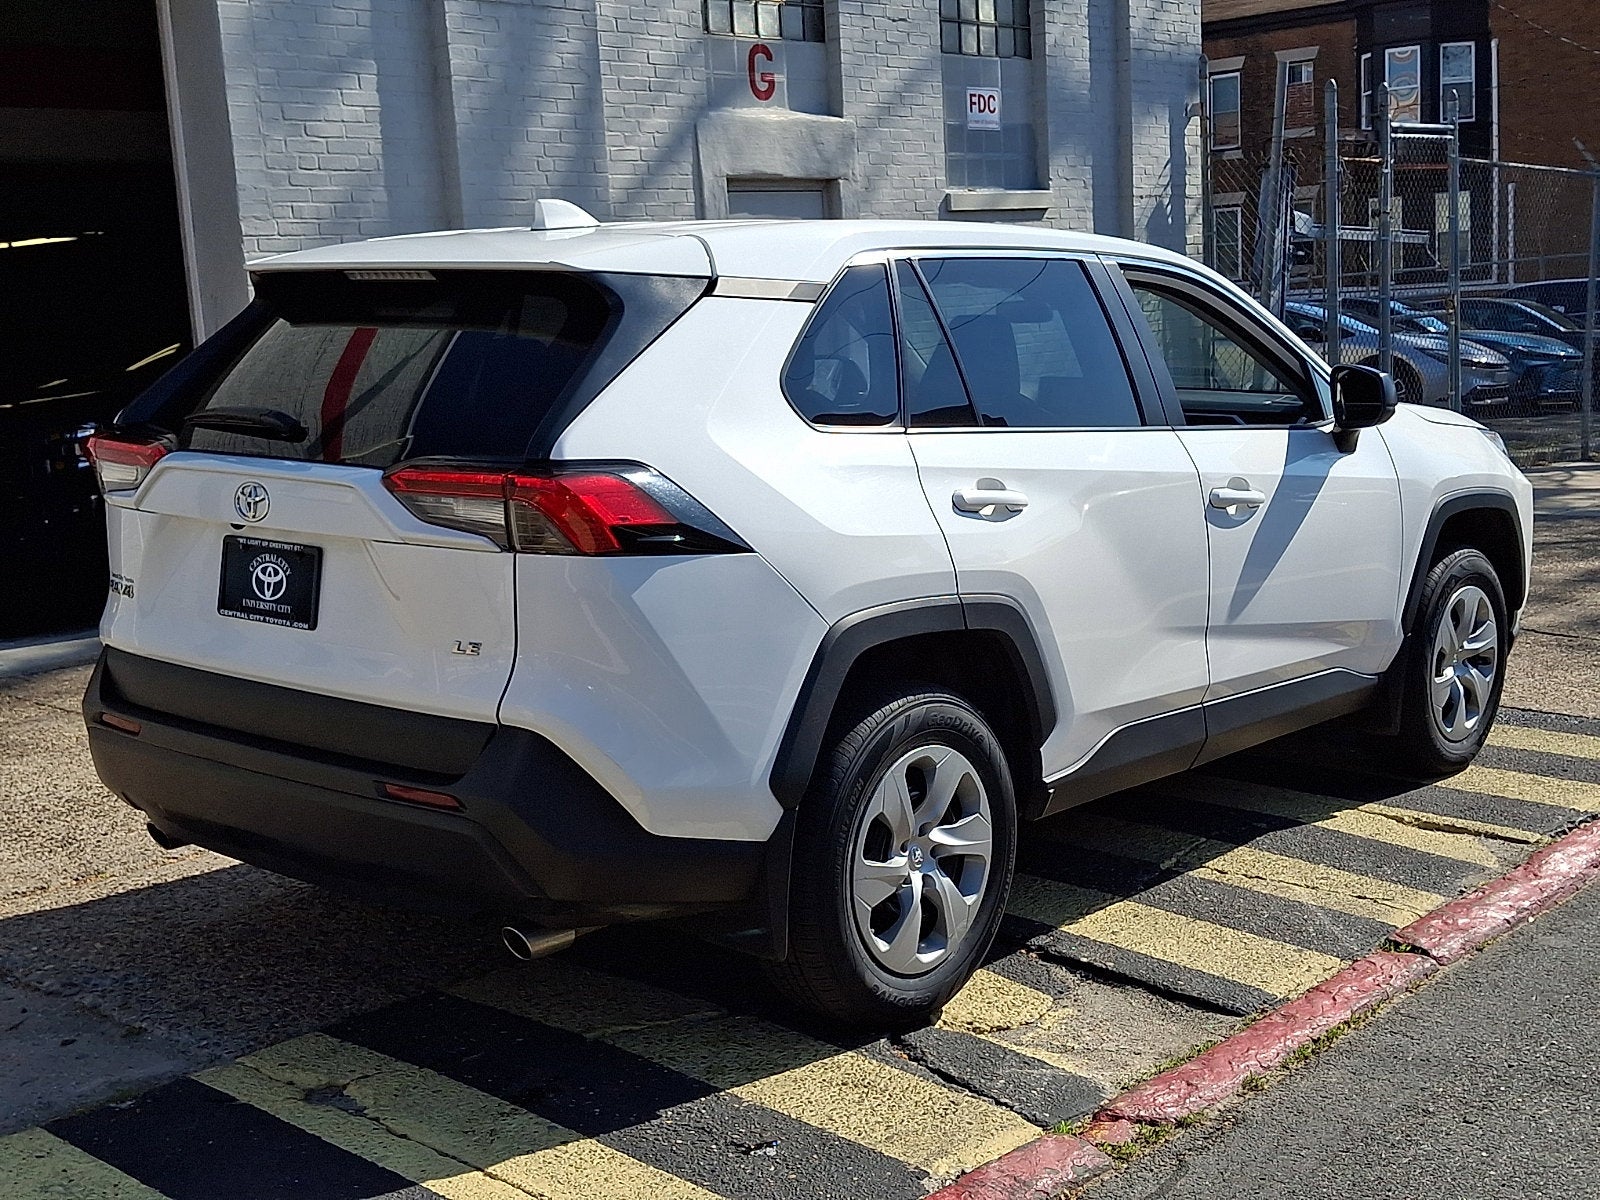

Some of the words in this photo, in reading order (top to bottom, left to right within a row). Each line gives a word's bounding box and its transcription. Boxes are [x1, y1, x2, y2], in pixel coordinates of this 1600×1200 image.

[748, 43, 776, 101] G
[969, 93, 996, 114] FDC
[249, 553, 277, 572] CENTRAL
[276, 556, 292, 576] CITY
[242, 598, 277, 612] UNIVERSITY
[277, 604, 293, 614] CITY
[220, 608, 249, 620] CENTRAL
[249, 613, 264, 622] CITY
[265, 616, 291, 627] TOYOTA
[452, 640, 482, 656] LE
